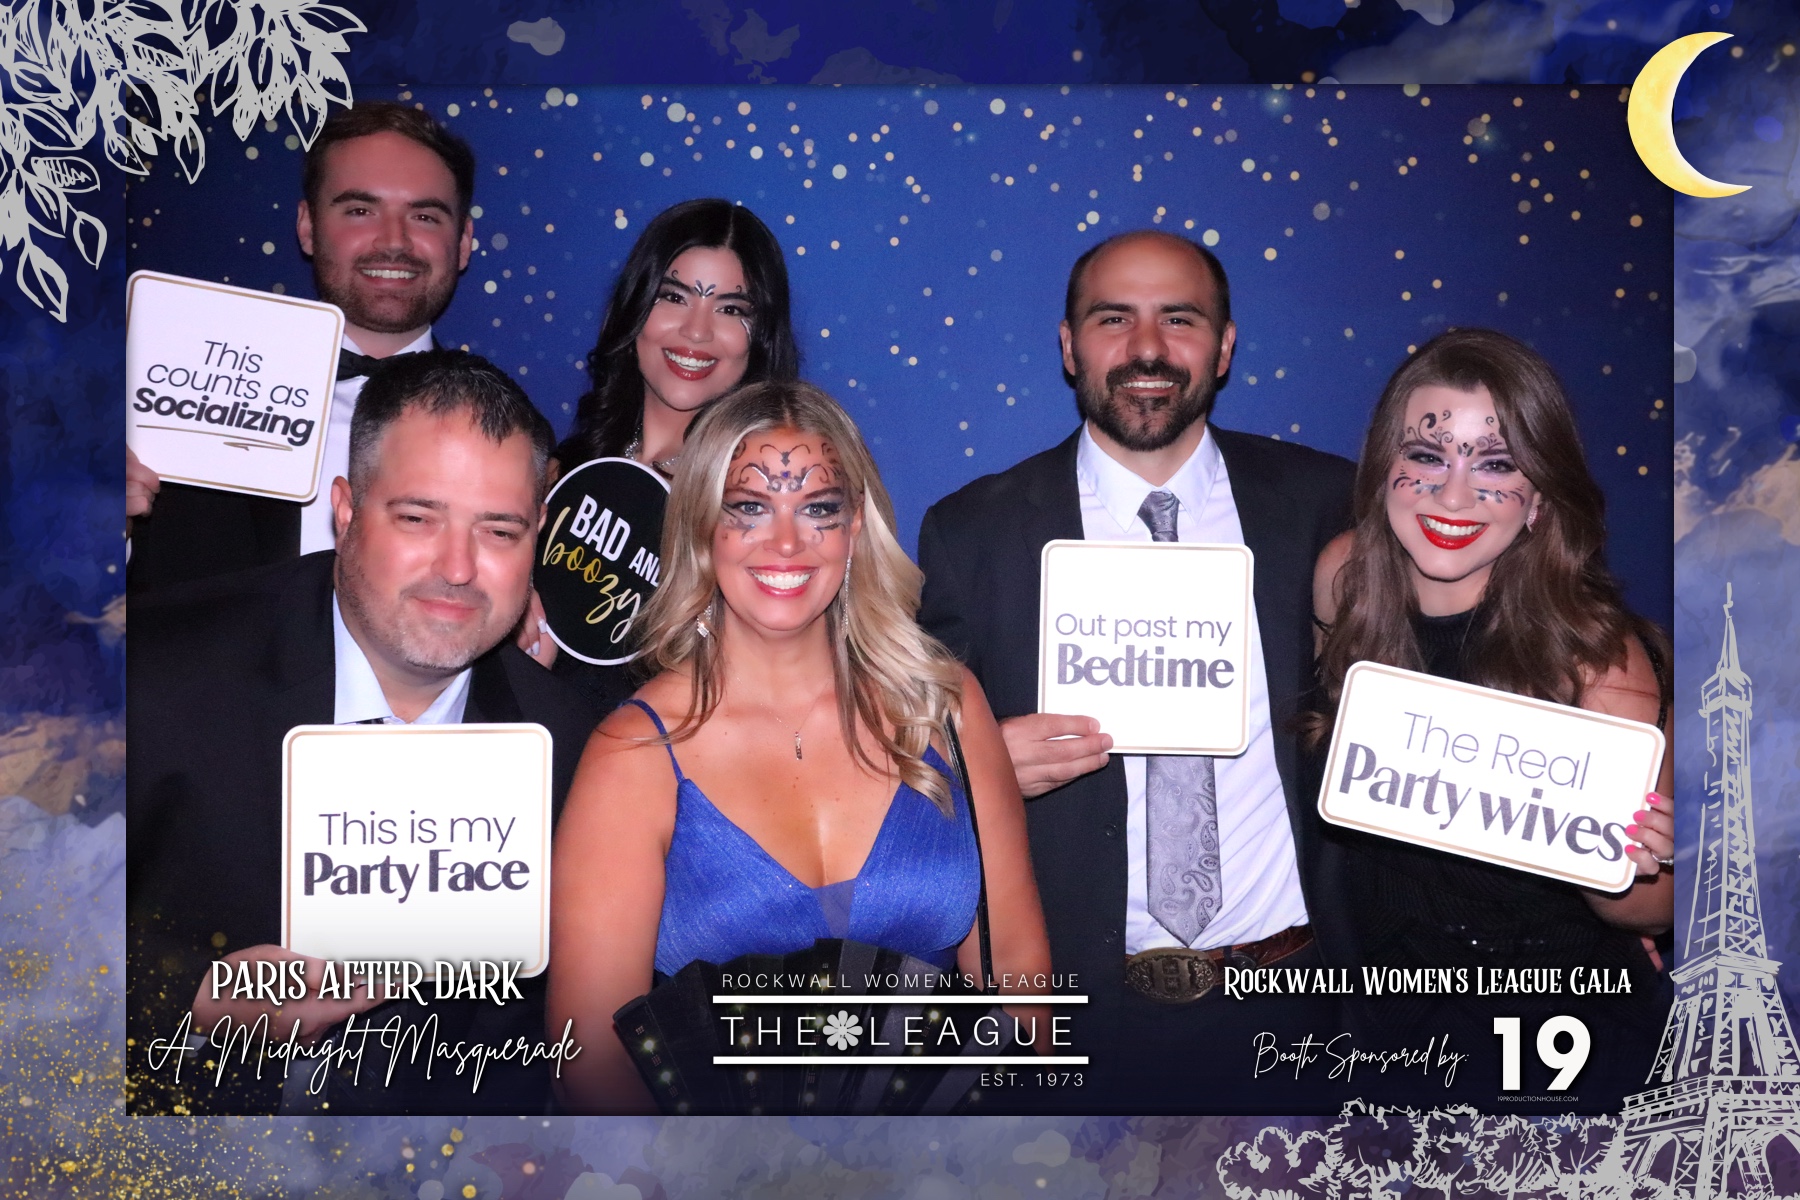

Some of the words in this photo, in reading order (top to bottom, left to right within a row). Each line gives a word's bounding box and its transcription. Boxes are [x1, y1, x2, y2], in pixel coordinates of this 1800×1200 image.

[204, 340, 263, 373] This
[147, 364, 261, 399] counts
[270, 385, 309, 408] as
[133, 387, 315, 447] Socializing
[569, 494, 631, 562] BAD
[543, 506, 641, 644] boozy
[1055, 613, 1106, 636] Out
[1114, 616, 1177, 645] past
[1186, 620, 1232, 647] my
[1057, 643, 1235, 689] Bedtime
[1404, 711, 1479, 763] The
[1491, 733, 1591, 790] Real
[1338, 742, 1472, 830] Party
[1479, 787, 1627, 862] wives
[319, 811, 397, 846] This
[409, 810, 437, 844] is
[450, 814, 516, 853] my
[303, 851, 419, 904] Party
[428, 849, 530, 893] Face
